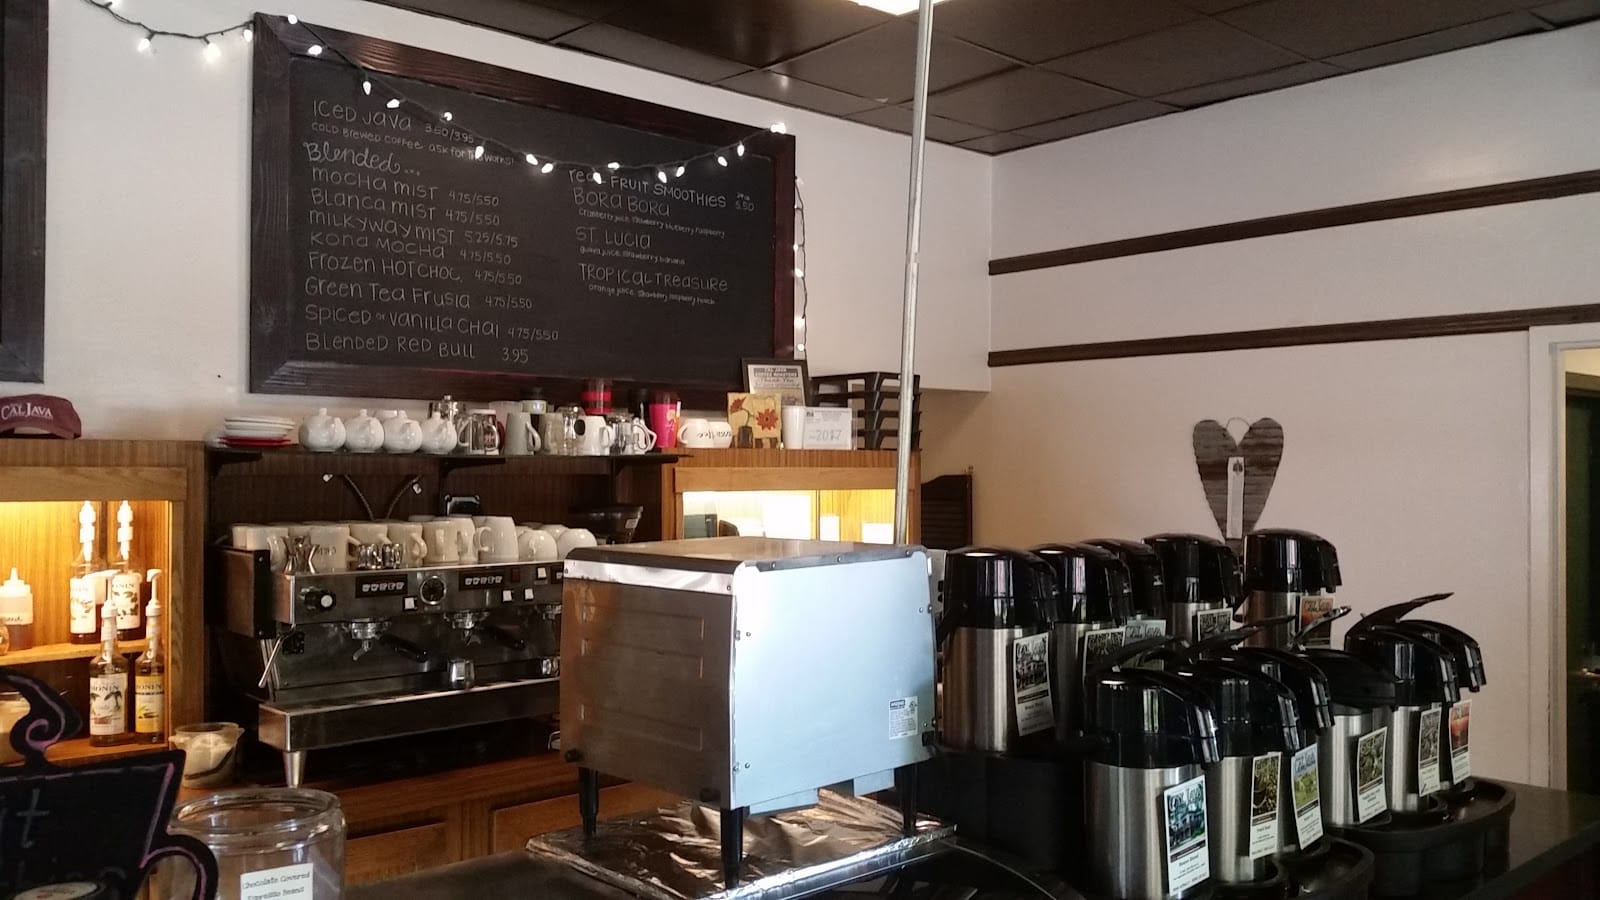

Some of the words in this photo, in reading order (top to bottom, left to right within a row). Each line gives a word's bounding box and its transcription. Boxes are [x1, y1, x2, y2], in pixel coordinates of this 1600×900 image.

[611, 176, 649, 193] FRUIT
[305, 276, 362, 298] Green
[369, 283, 405, 302] Tea
[242, 877, 278, 889] Chocolate
[280, 872, 310, 882] Covered
